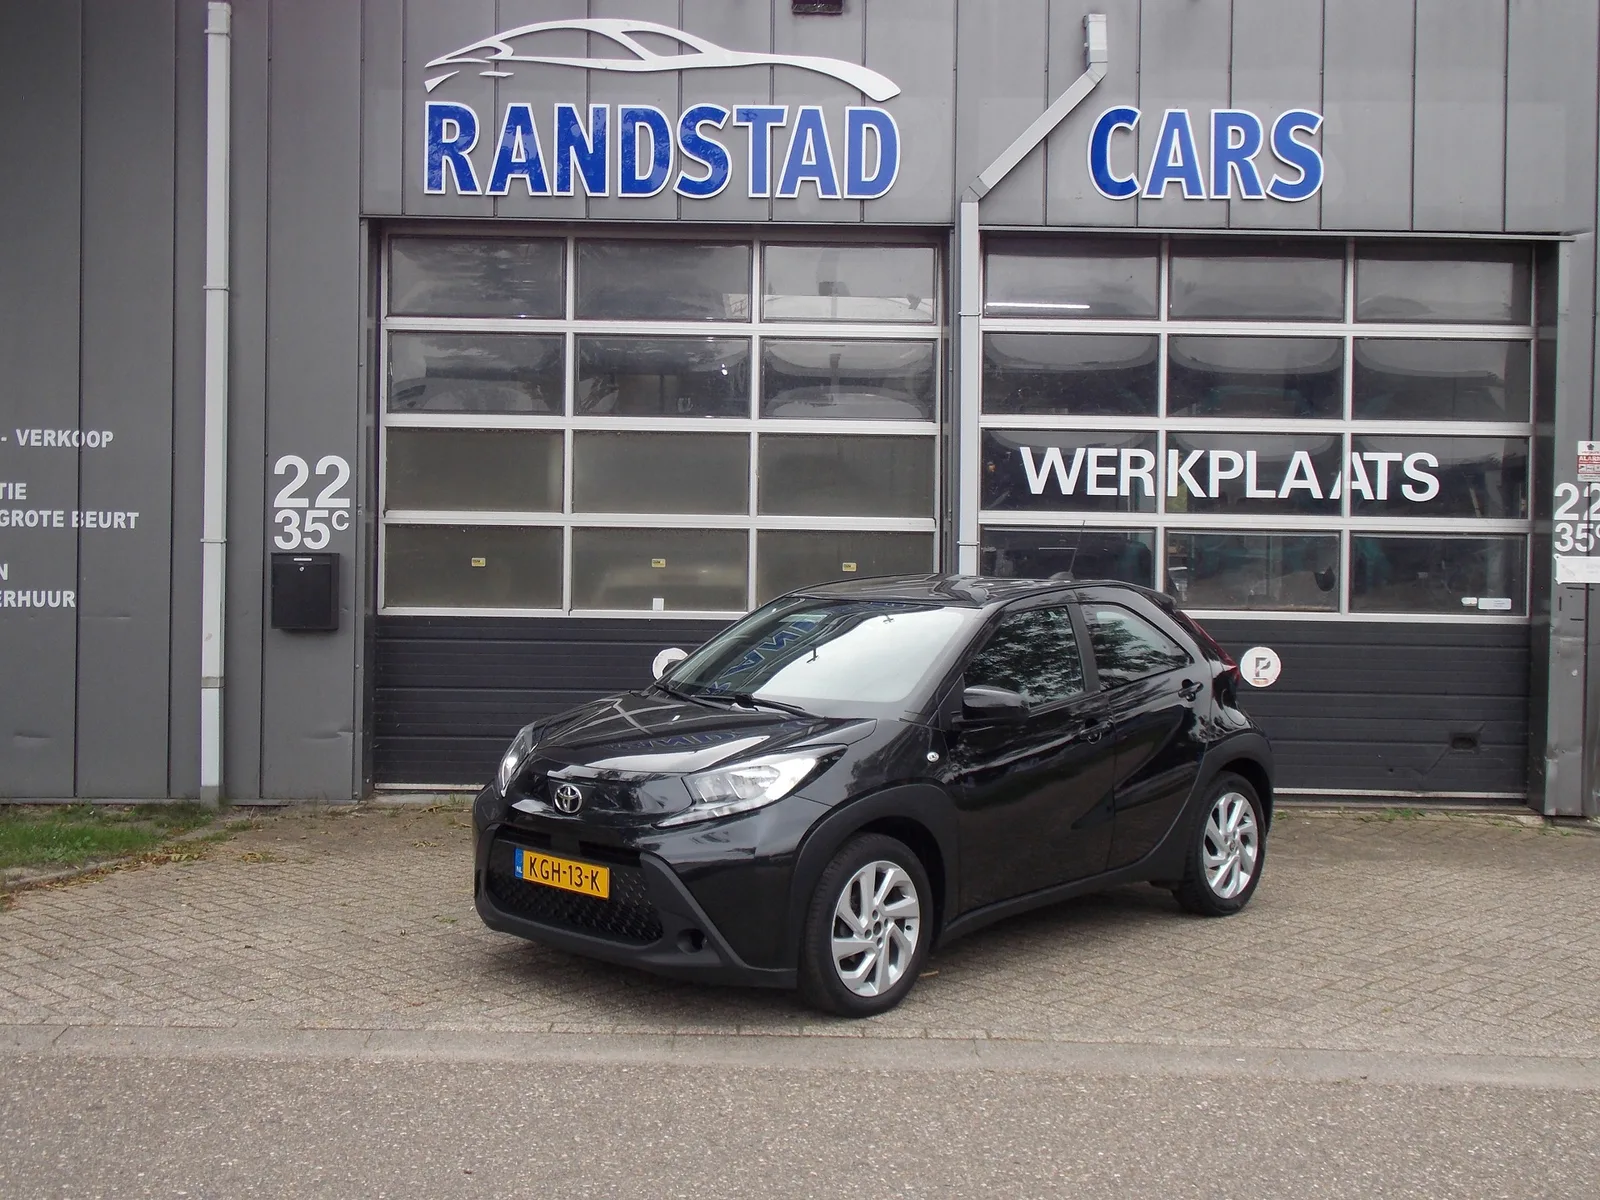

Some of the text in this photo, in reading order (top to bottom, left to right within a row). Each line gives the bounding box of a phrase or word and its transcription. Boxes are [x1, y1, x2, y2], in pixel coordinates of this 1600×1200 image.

[423, 101, 1325, 202] RANDSTAD CARS
[16, 429, 114, 448] VERKOOP
[273, 455, 351, 508] 22
[1020, 446, 1440, 502] WERKPLAATS
[0, 510, 139, 529] GROTE BEURT
[1554, 483, 1600, 521] 22
[0, 590, 76, 608] RHUUR
[529, 856, 601, 893] KGH-13-K
